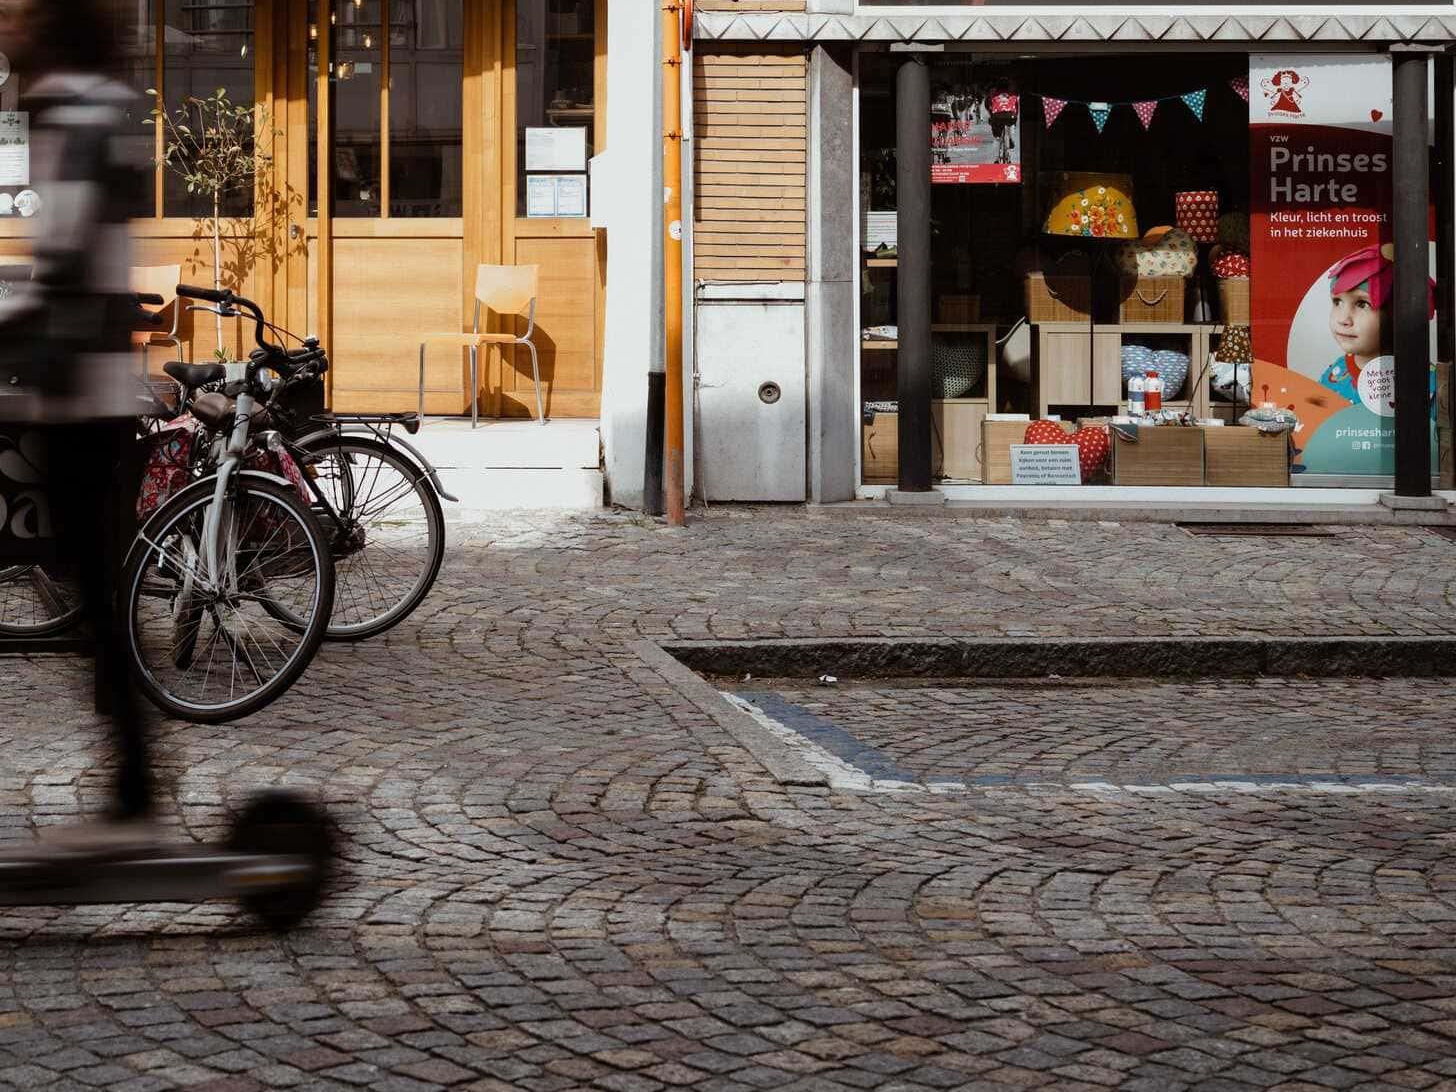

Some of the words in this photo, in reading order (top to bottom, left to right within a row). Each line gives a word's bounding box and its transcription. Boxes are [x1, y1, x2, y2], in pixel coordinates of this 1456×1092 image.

[1270, 146, 1388, 172] Prinses
[1270, 177, 1358, 202] Harte
[1270, 212, 1304, 224] Kleur,
[1307, 212, 1332, 222] licht
[1335, 214, 1349, 222] en
[1352, 213, 1387, 222] troost
[1271, 227, 1282, 237] in
[1284, 227, 1304, 237] het
[1306, 227, 1368, 237] ziekenhuis
